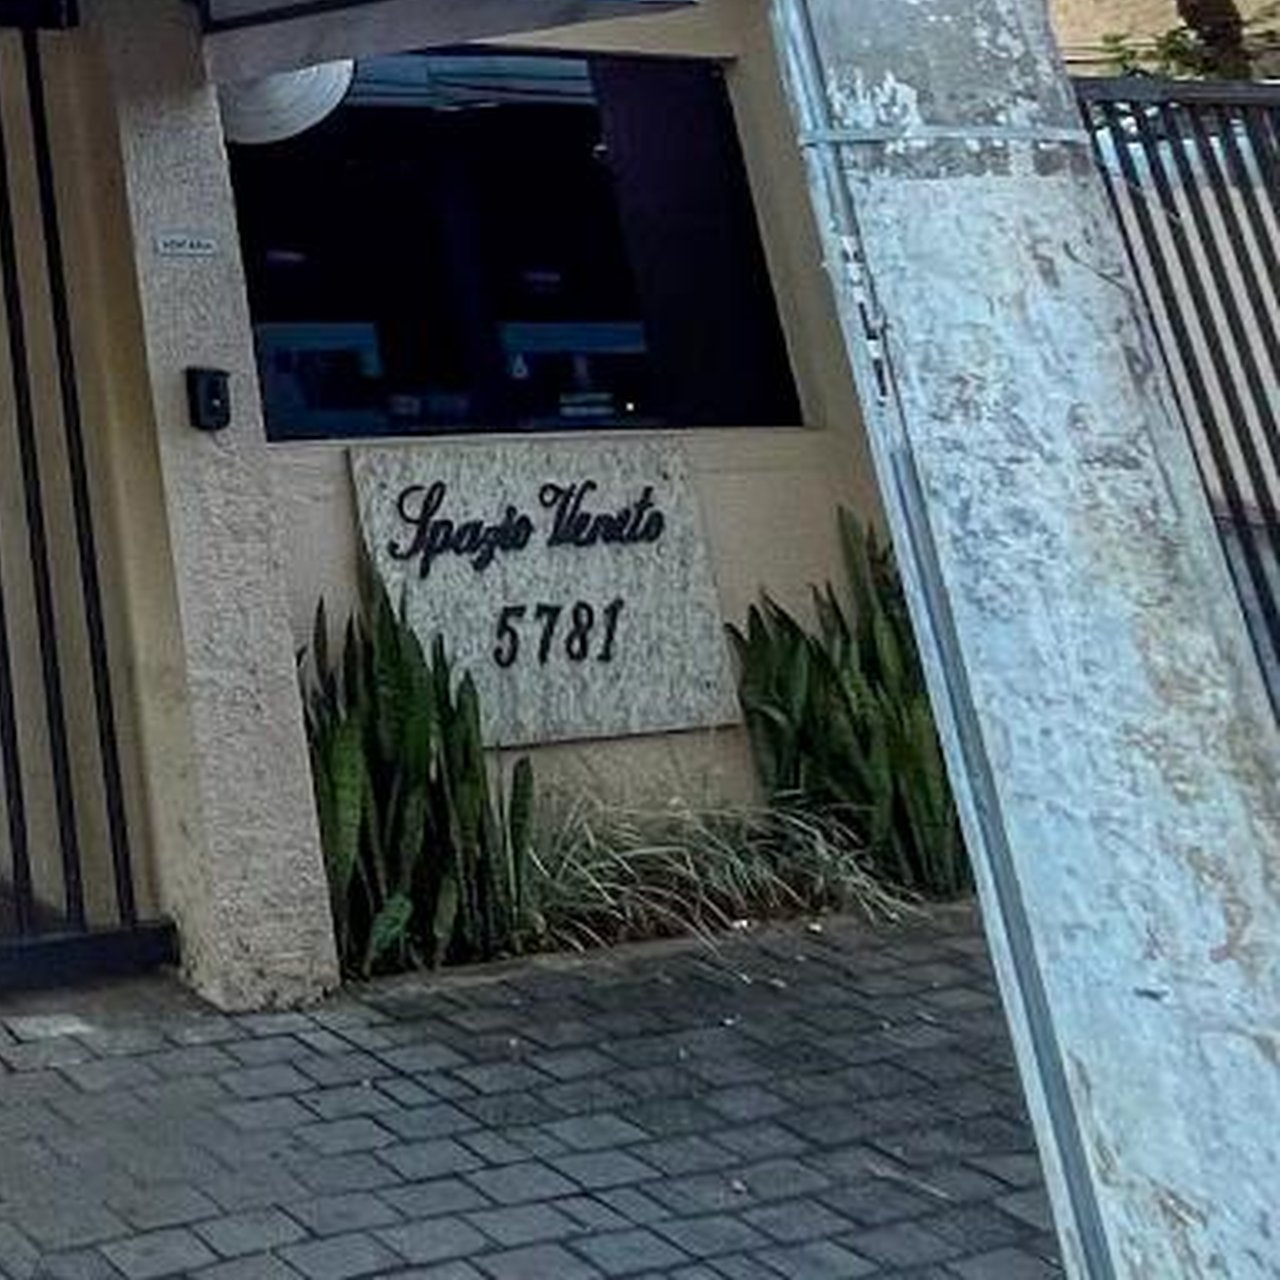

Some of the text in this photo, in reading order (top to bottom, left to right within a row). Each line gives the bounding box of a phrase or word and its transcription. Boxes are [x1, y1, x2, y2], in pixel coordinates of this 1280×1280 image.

[388, 480, 666, 579] Spazio Veneto
[493, 598, 626, 668] 5781
